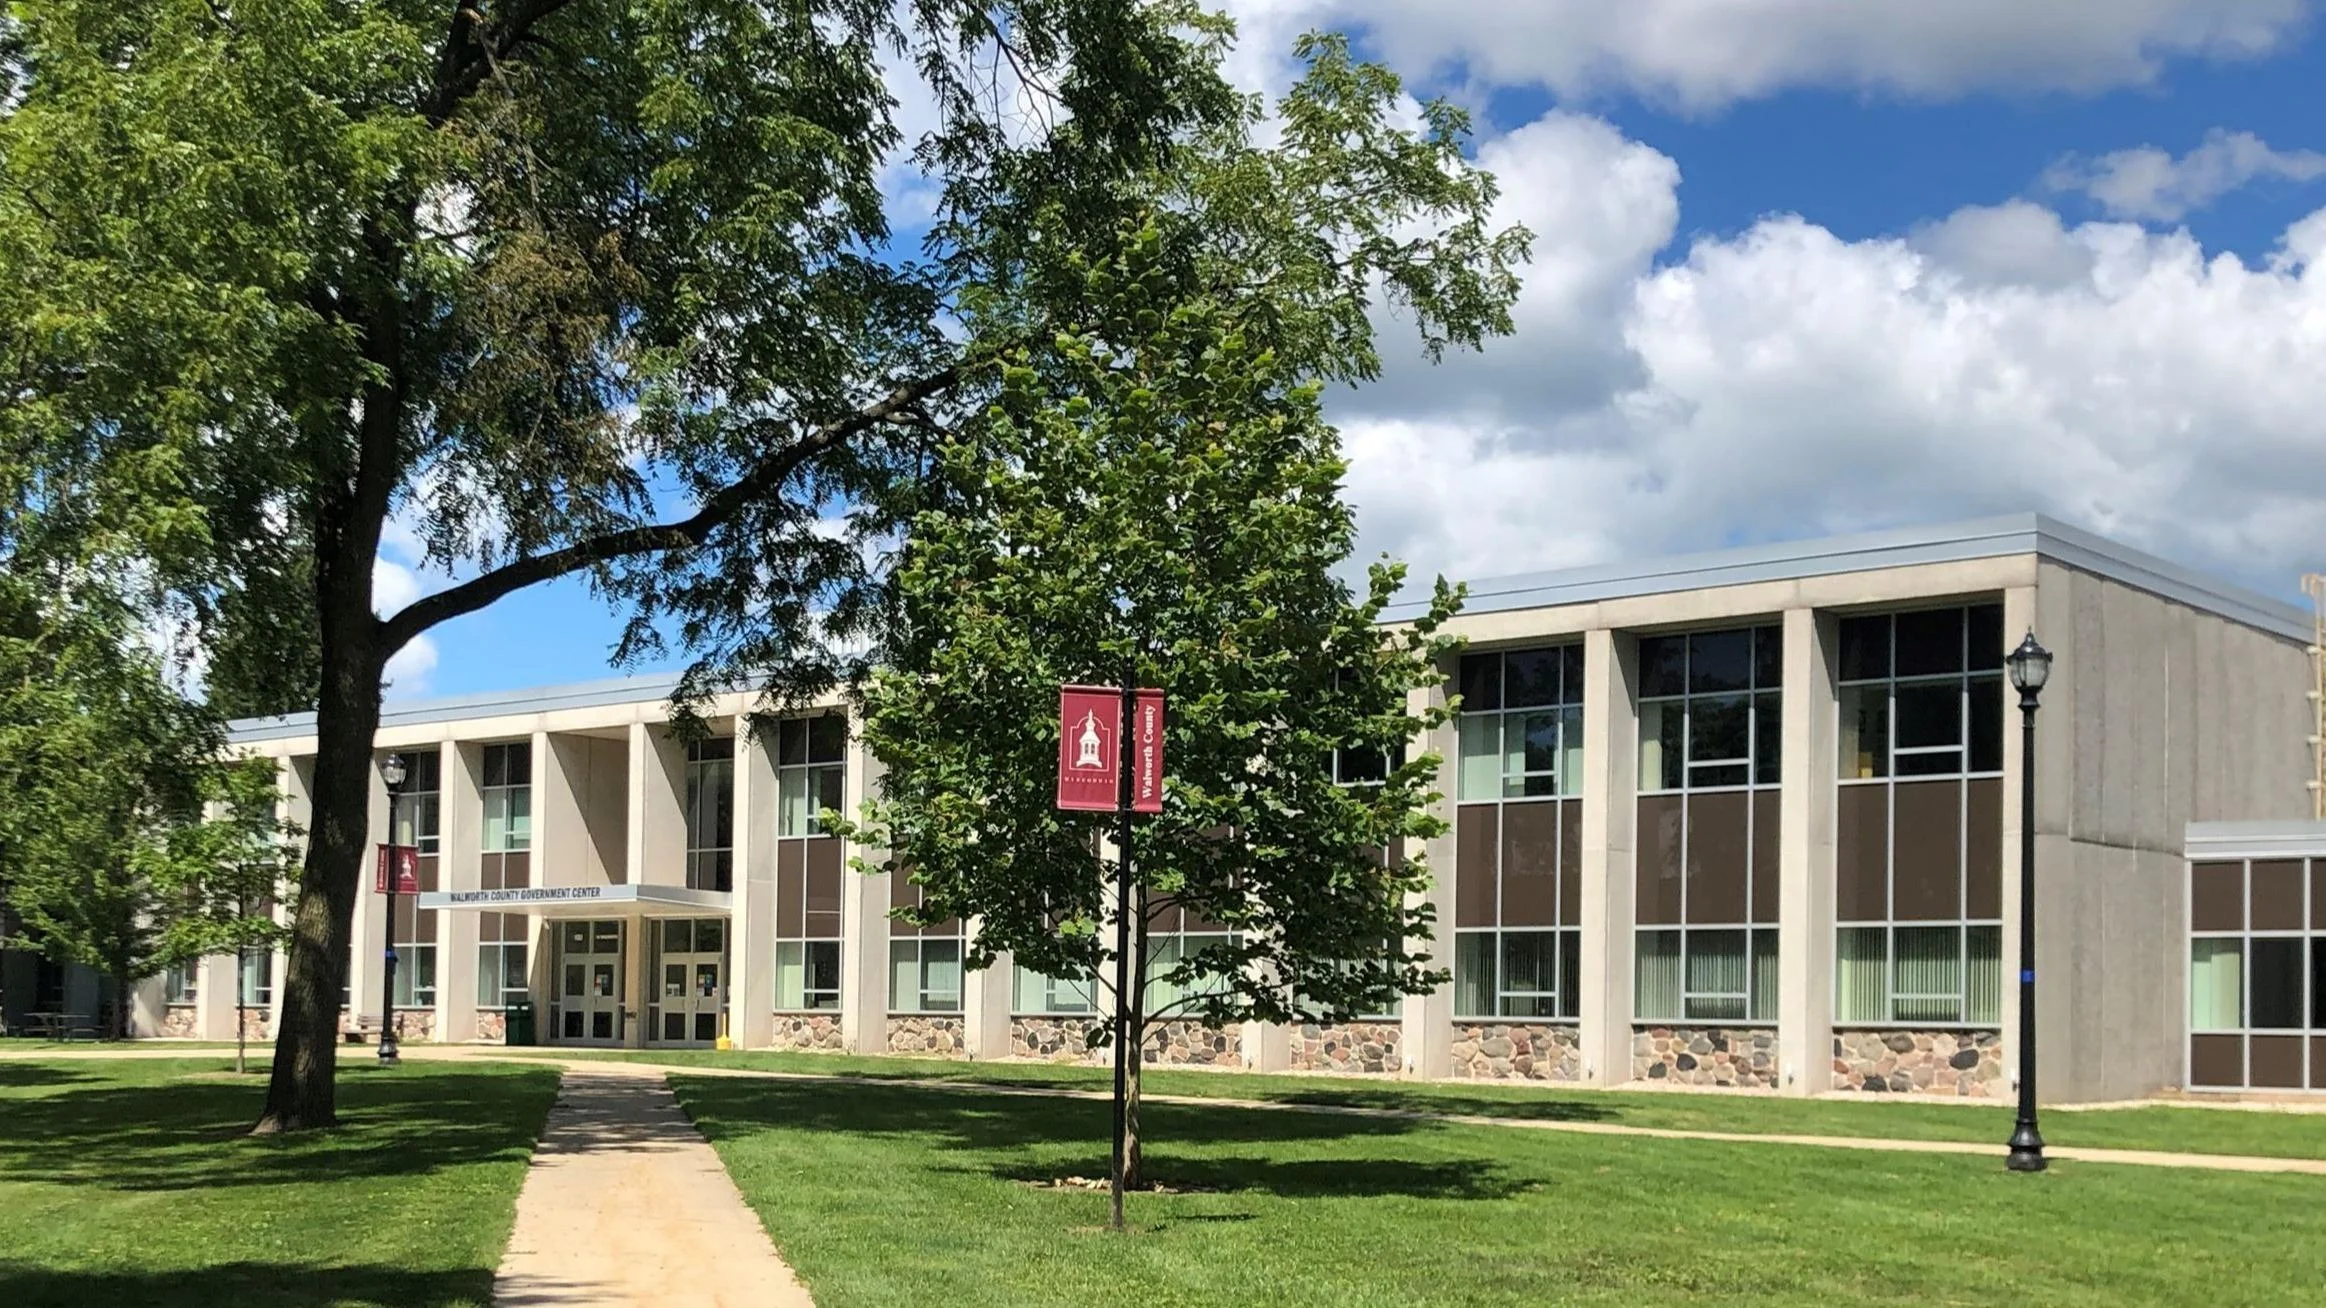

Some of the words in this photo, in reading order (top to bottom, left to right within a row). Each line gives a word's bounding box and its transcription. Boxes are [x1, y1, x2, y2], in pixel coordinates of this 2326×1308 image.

[1143, 705, 1155, 743] County
[1142, 746, 1153, 798] Walworth
[450, 891, 489, 902] WALWORTH
[490, 890, 519, 901] COUNTY
[520, 888, 571, 900] GOVERNMENT
[572, 887, 601, 898] CENTER
